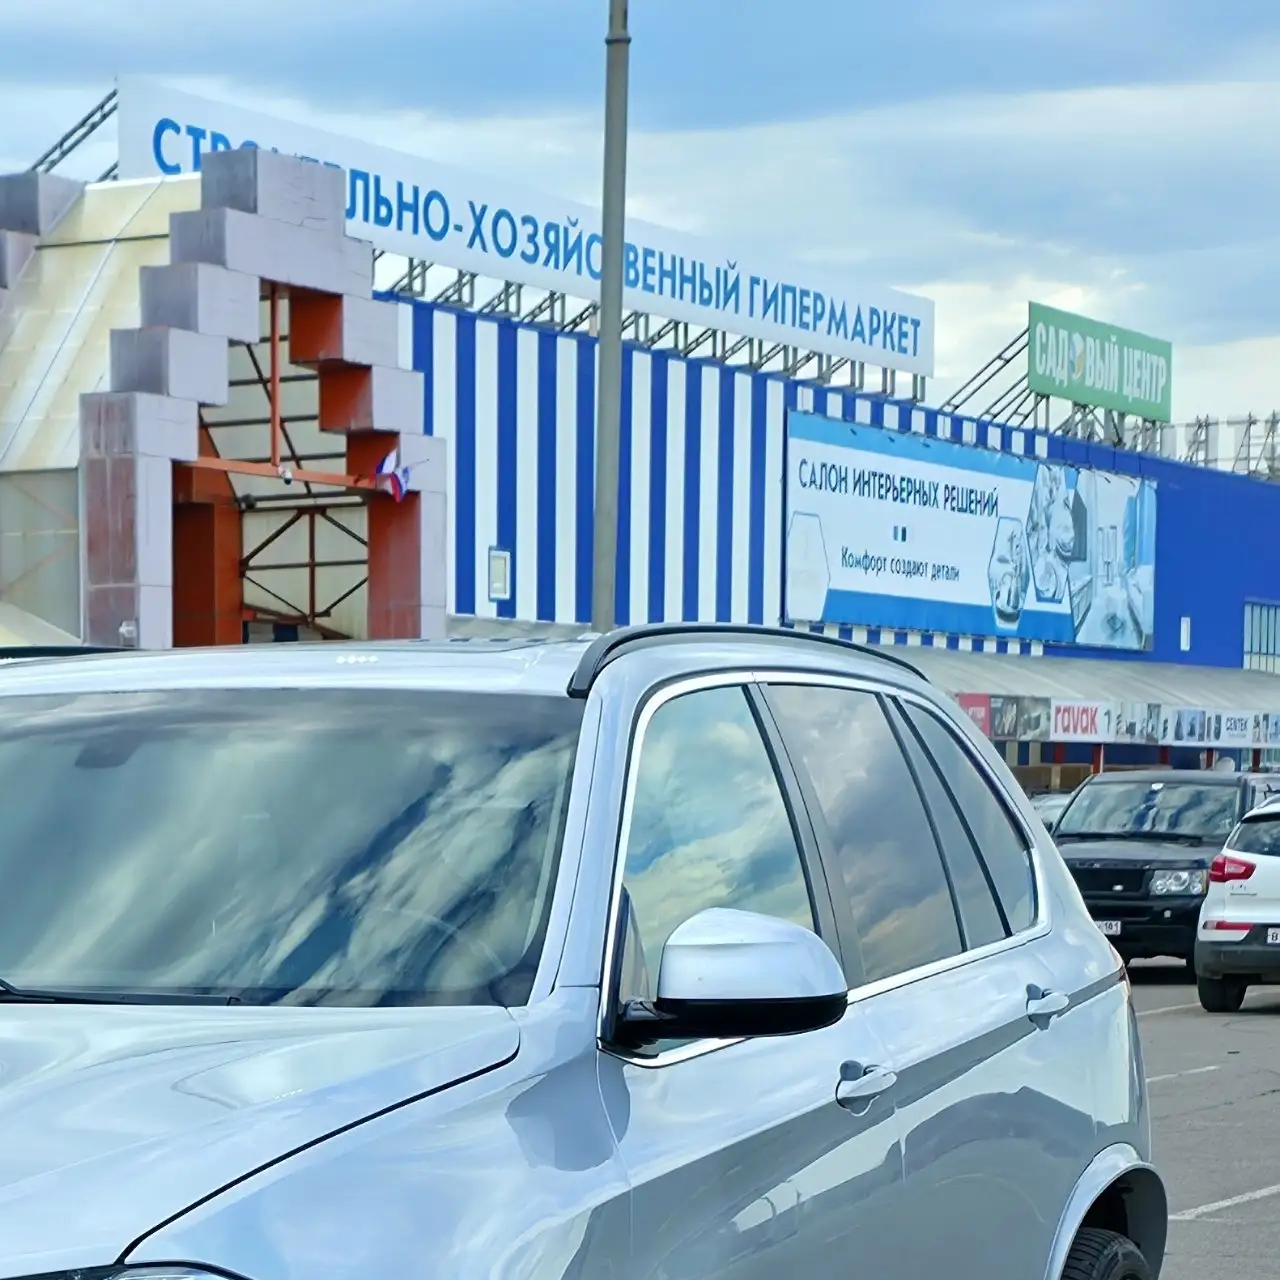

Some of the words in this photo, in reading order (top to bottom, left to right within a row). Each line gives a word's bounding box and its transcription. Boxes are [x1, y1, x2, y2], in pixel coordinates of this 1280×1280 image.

[152, 117, 740, 315] СТЛЬНО-ХОЗЯЙСВЕННЫЙ
[748, 275, 921, 358] ГИПЕРМАРКЕТ
[1123, 345, 1167, 404] ЦЕНТР
[798, 457, 848, 494] САЛОН
[852, 467, 939, 510] ИНТЕРЬЕРНЫХ
[943, 484, 999, 518] РЕШЕНИЙ
[841, 545, 888, 577] Комфорт
[890, 559, 929, 579] создают
[931, 562, 961, 582] детали
[1054, 705, 1099, 735] ravak
